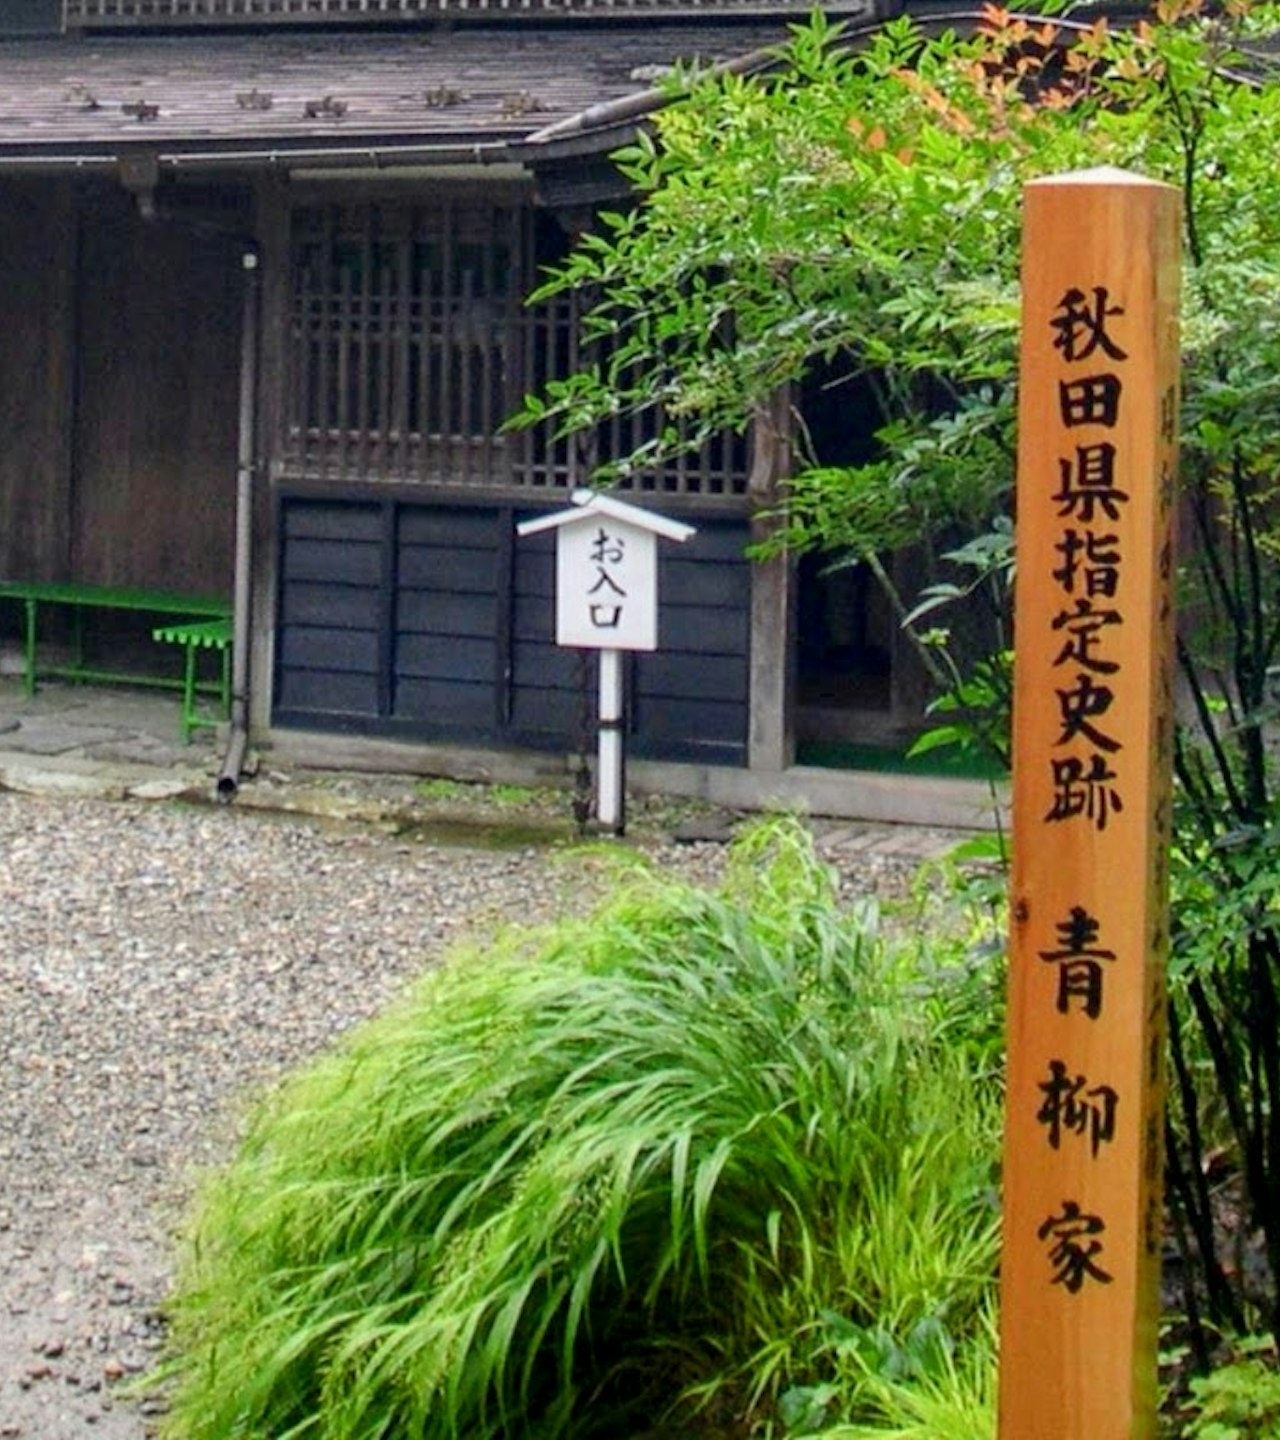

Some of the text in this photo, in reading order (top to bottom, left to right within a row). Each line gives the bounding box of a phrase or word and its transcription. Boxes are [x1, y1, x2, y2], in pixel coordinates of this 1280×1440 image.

[588, 528, 626, 628] お入口
[1037, 286, 1129, 1295] 秋田県指定史跡 青柳家
